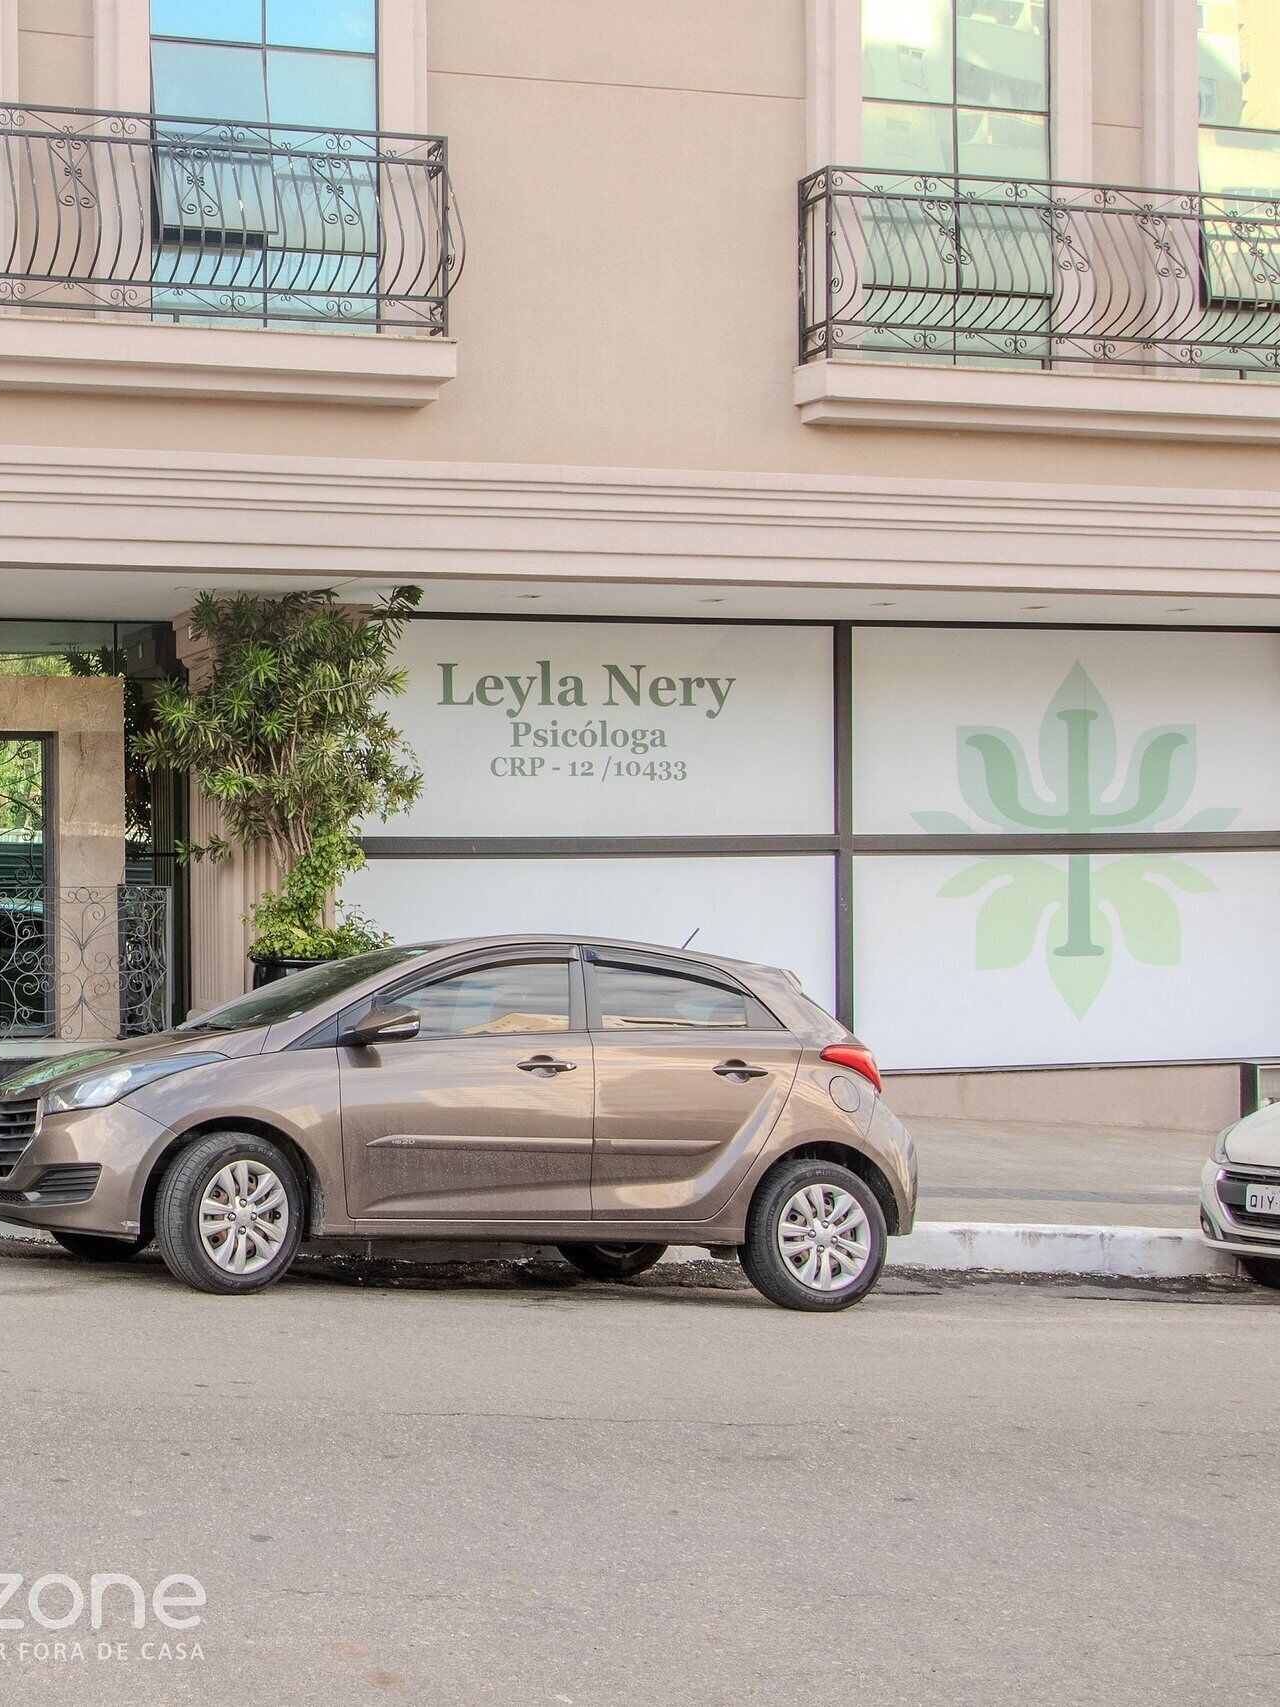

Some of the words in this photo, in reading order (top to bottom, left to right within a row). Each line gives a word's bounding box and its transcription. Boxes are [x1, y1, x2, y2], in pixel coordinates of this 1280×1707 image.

[437, 660, 588, 718] Leyla
[602, 664, 736, 719] Nery
[510, 720, 667, 754] Psicóloga
[490, 756, 545, 777] CRP
[568, 761, 595, 777] 12
